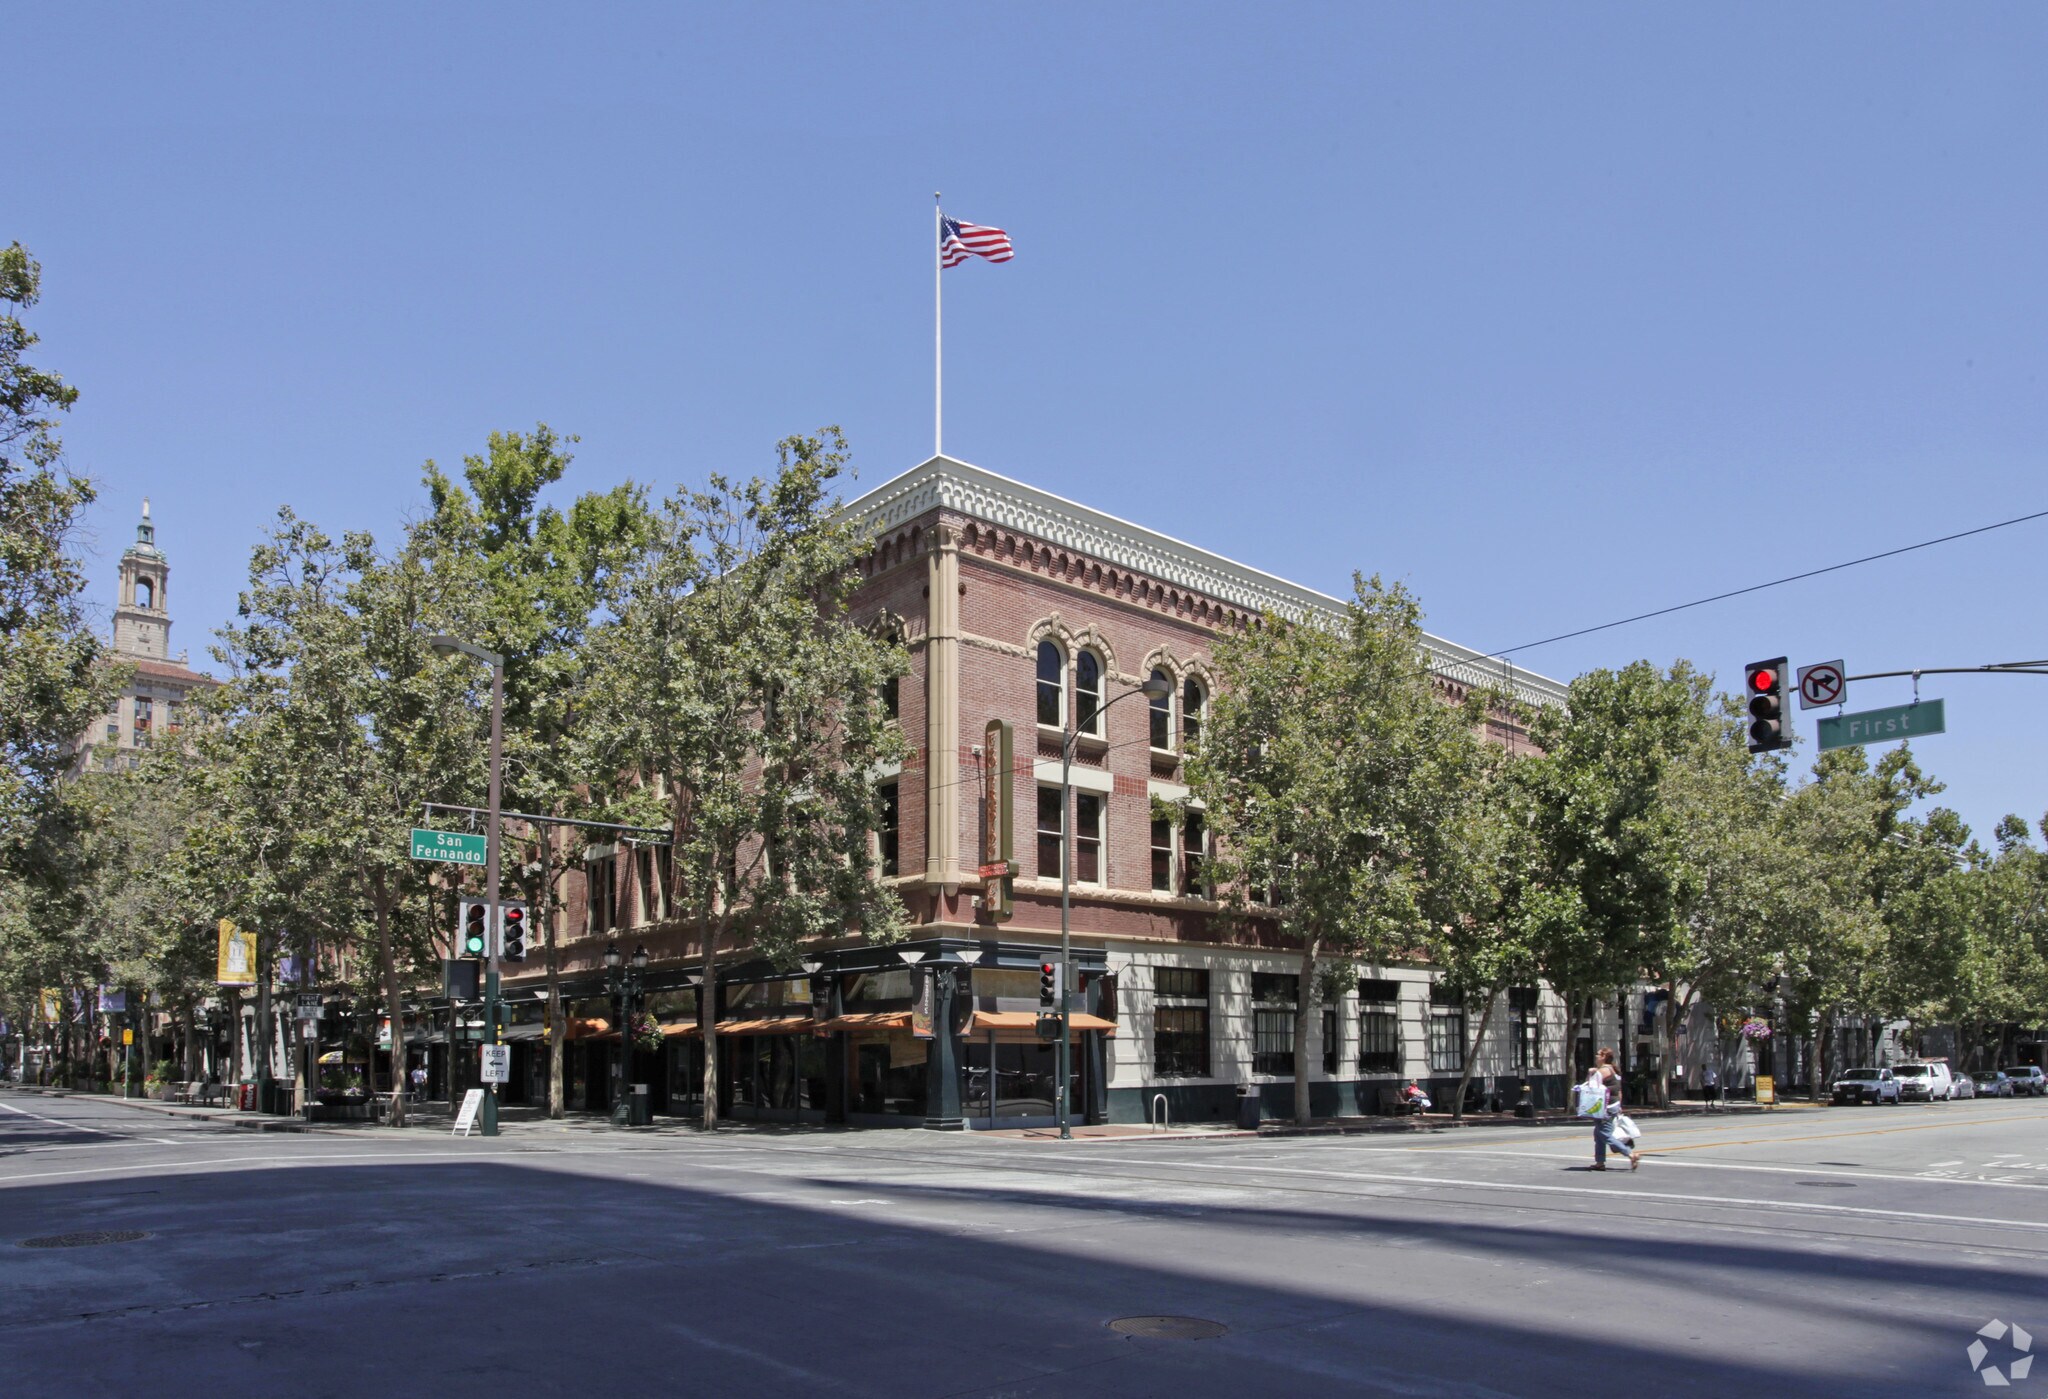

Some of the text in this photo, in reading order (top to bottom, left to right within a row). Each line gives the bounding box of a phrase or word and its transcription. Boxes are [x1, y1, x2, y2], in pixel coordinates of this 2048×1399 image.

[1849, 713, 1910, 738] First
[436, 833, 463, 847] San
[416, 844, 481, 862] Fernando
[485, 1050, 506, 1058] KEEP
[485, 1070, 505, 1078] LEFT
